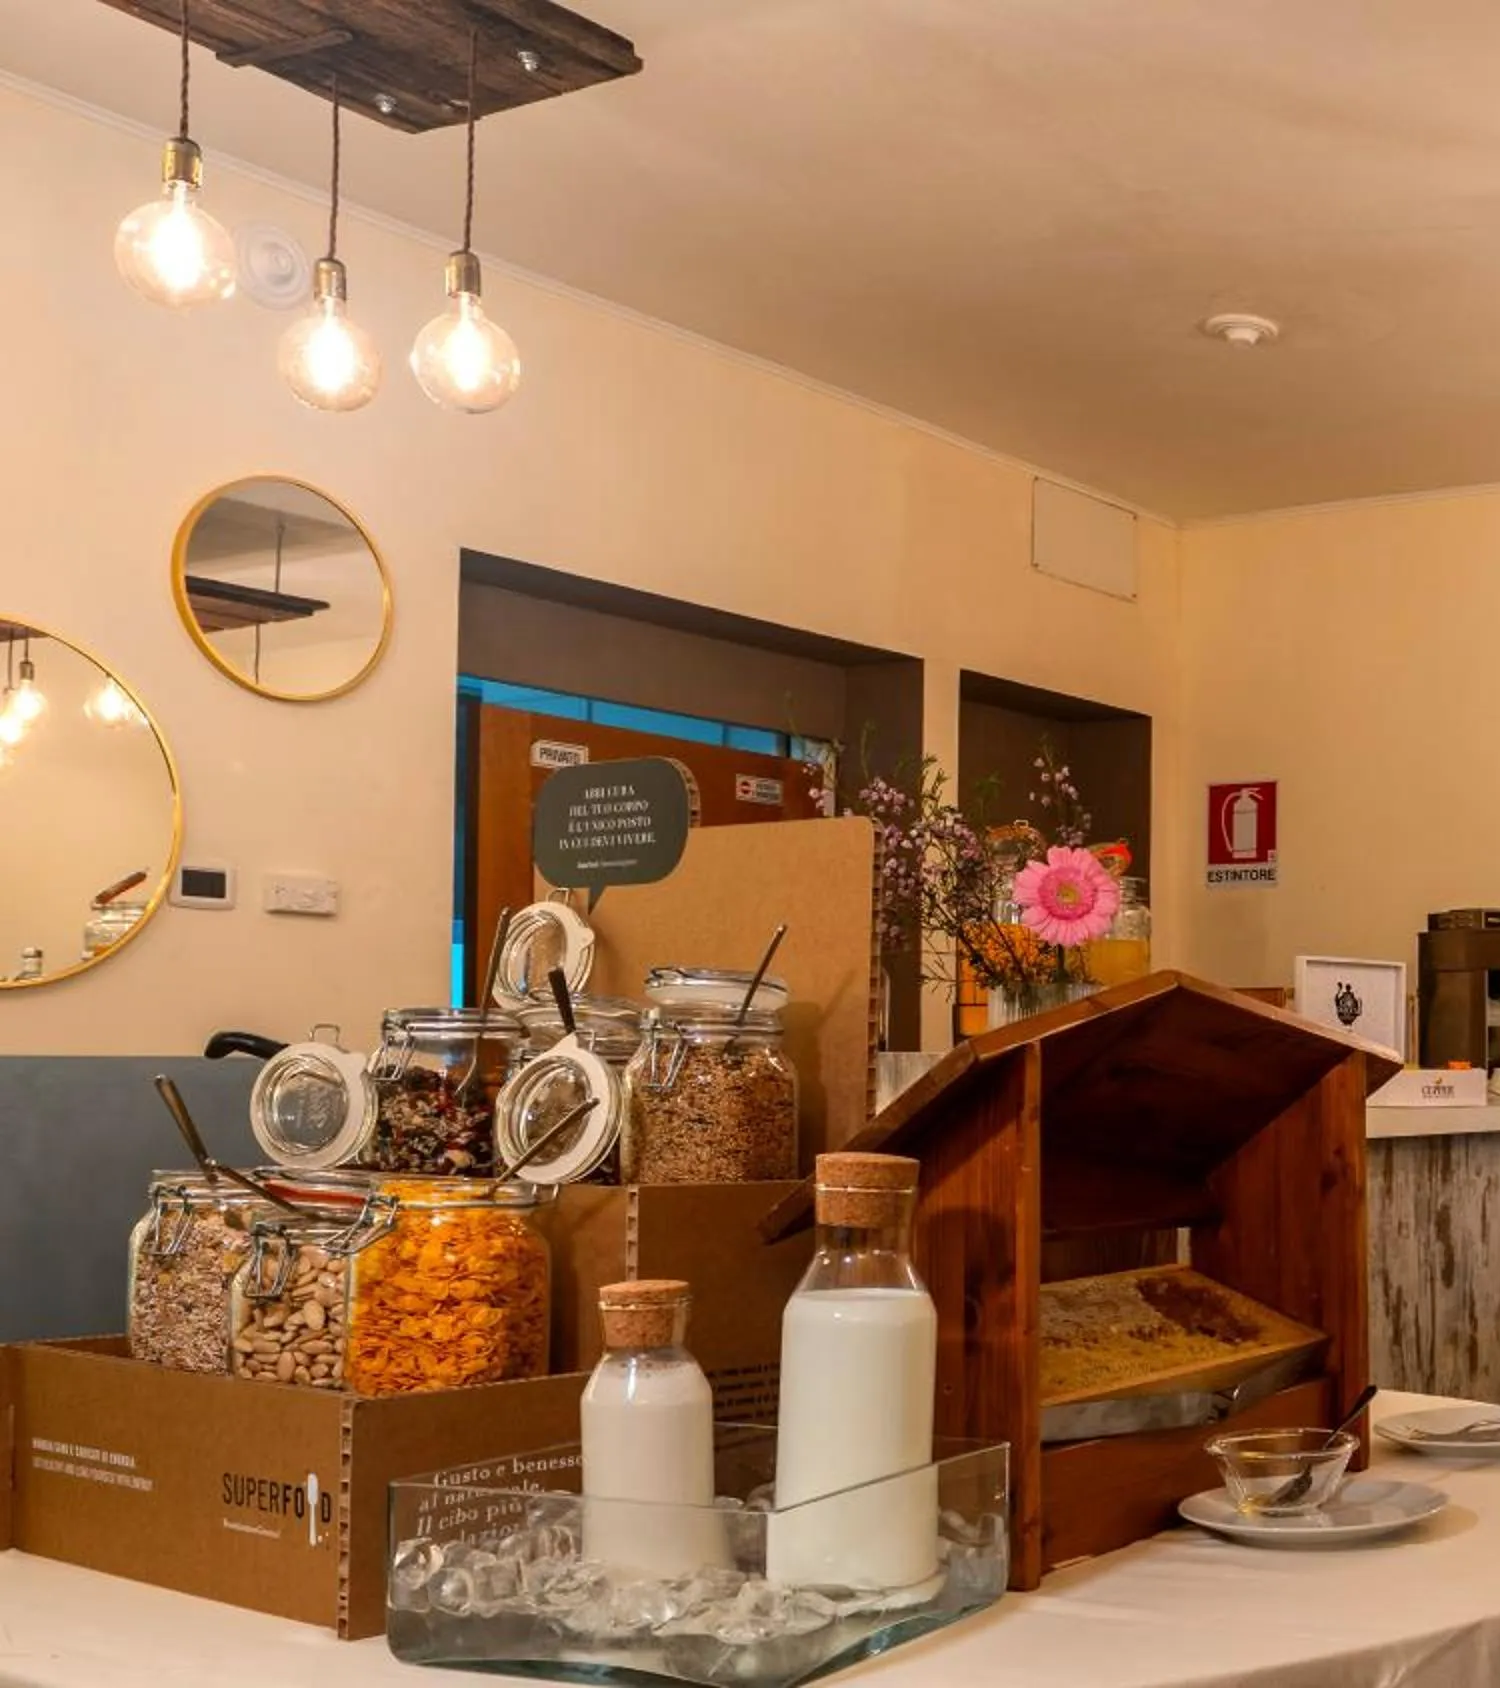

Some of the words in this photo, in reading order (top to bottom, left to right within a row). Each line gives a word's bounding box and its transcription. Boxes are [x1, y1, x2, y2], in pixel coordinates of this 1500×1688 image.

[1207, 868, 1276, 883] ESTINTORE
[433, 1468, 490, 1489] Gusto
[496, 1463, 506, 1477] e
[416, 1514, 432, 1537] Il
[439, 1507, 479, 1530] cibo
[486, 1497, 523, 1522] più
